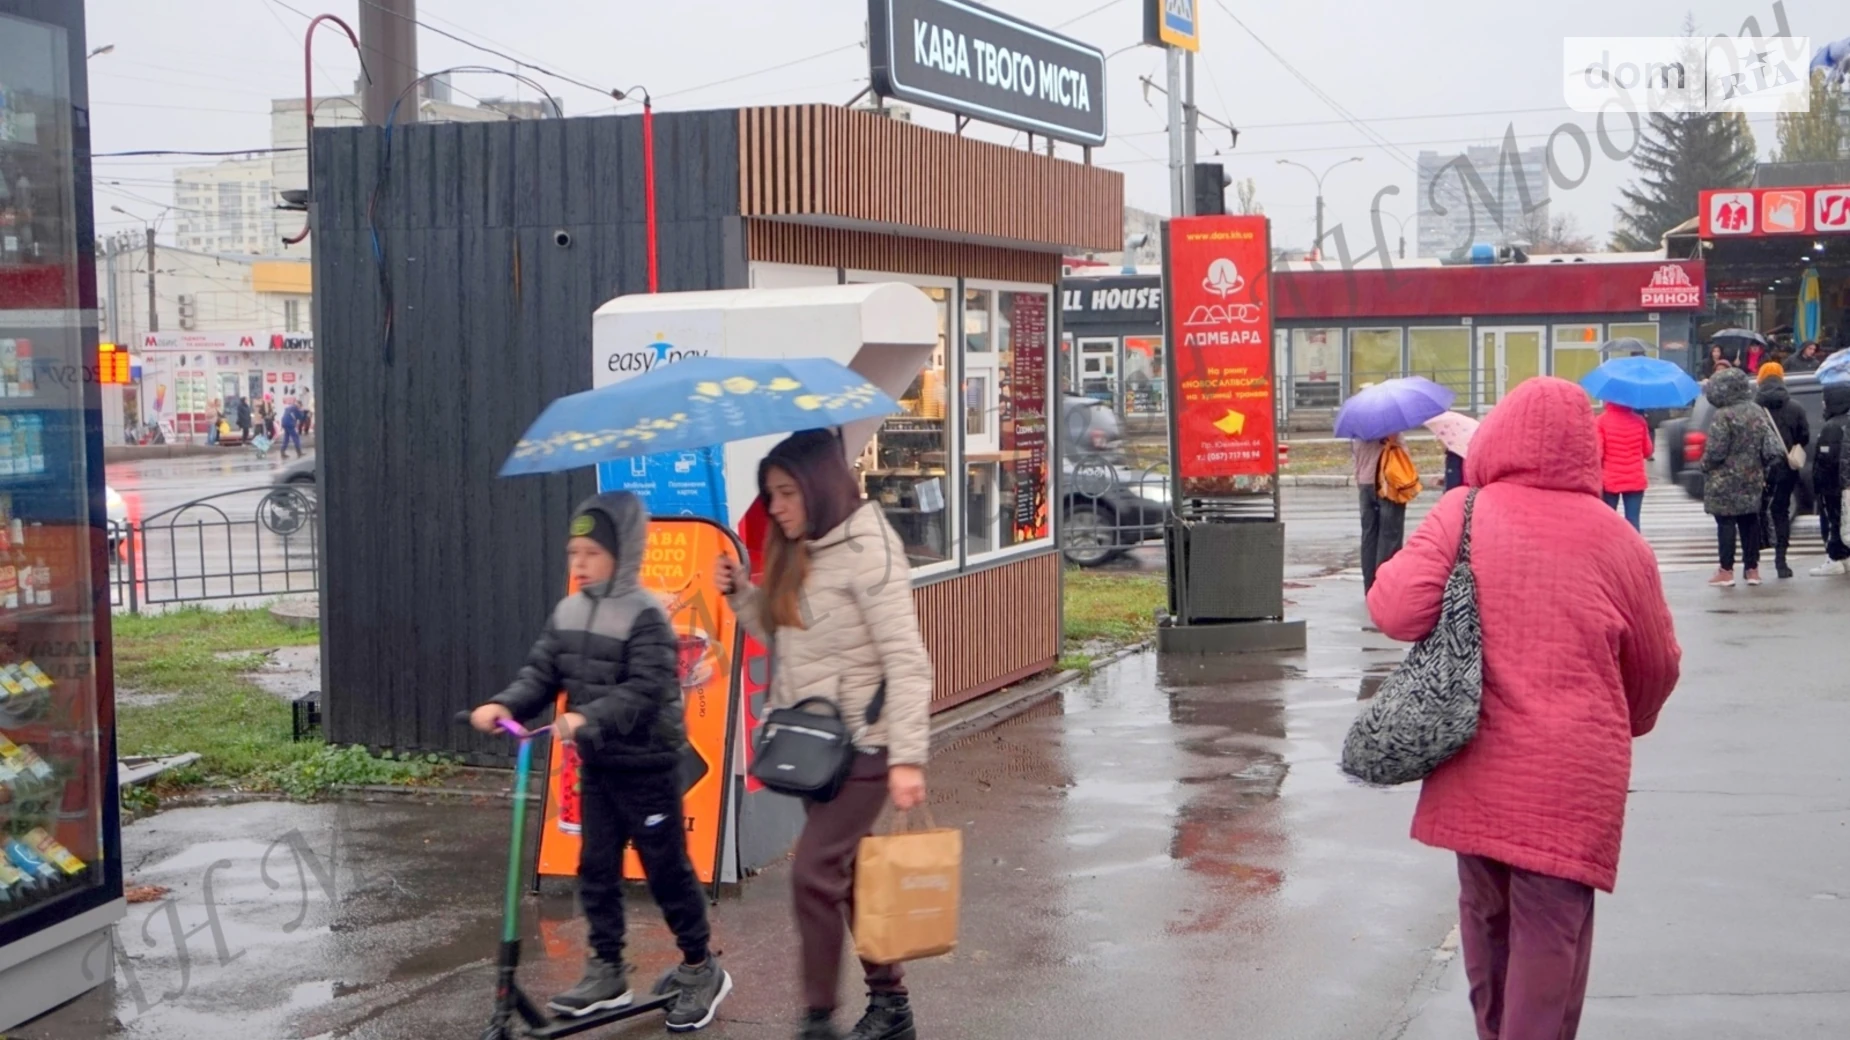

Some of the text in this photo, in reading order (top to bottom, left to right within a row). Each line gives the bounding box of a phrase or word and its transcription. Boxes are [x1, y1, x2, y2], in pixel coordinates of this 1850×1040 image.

[913, 19, 1091, 112] КАВА ТВОГО МІСТА
[1091, 287, 1161, 311] HOUSE
[1641, 293, 1700, 304] РИНОК
[1184, 330, 1262, 346] ЛОМБАРД
[647, 531, 688, 546] АВА
